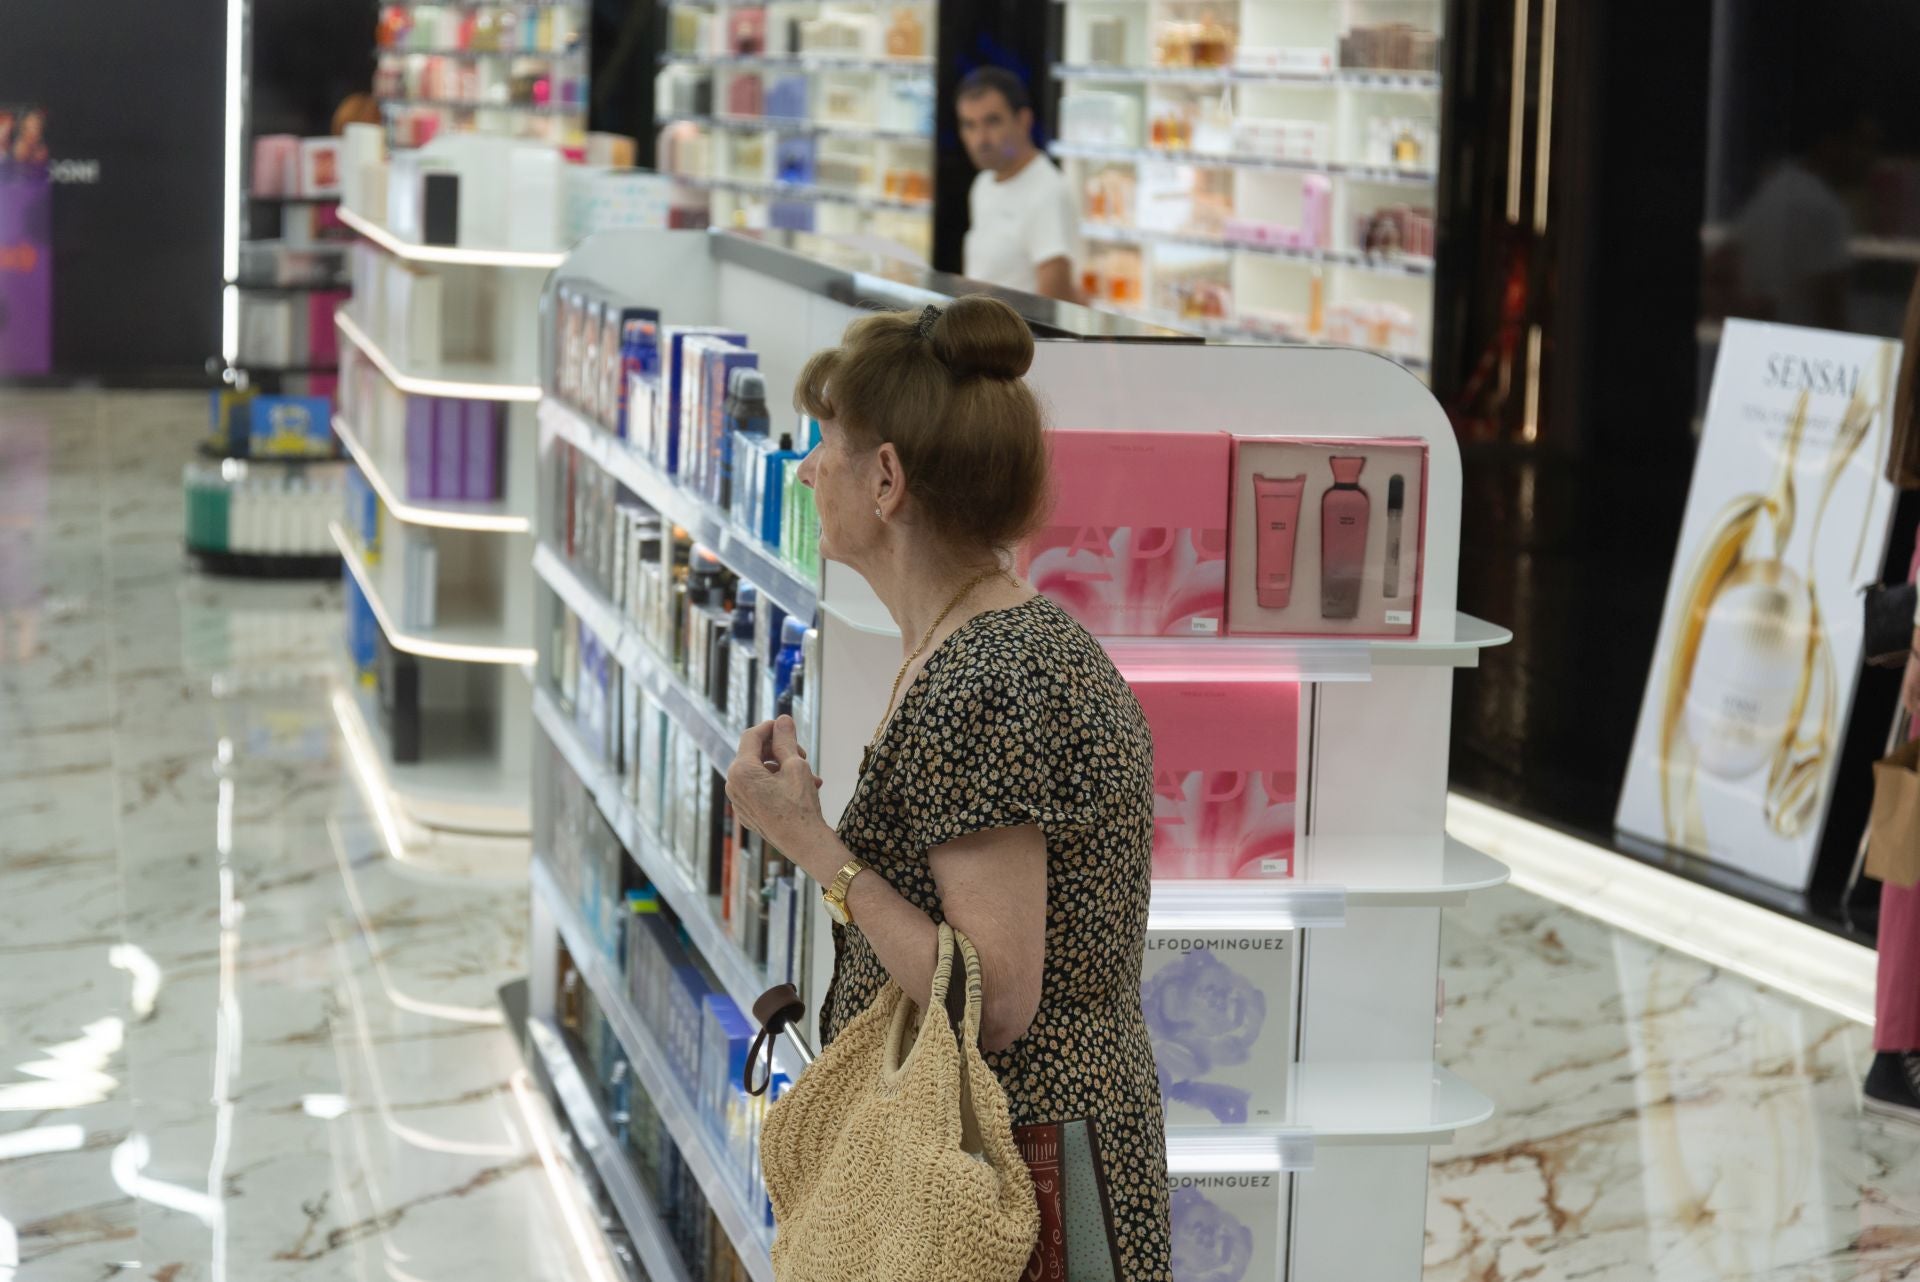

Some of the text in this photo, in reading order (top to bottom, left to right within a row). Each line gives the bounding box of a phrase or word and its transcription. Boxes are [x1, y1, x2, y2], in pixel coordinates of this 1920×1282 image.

[1763, 352, 1860, 398] SENSAI
[1144, 938, 1284, 955] LFODOMINGUEZ
[1168, 1176, 1271, 1193] DOMINGUEZ
